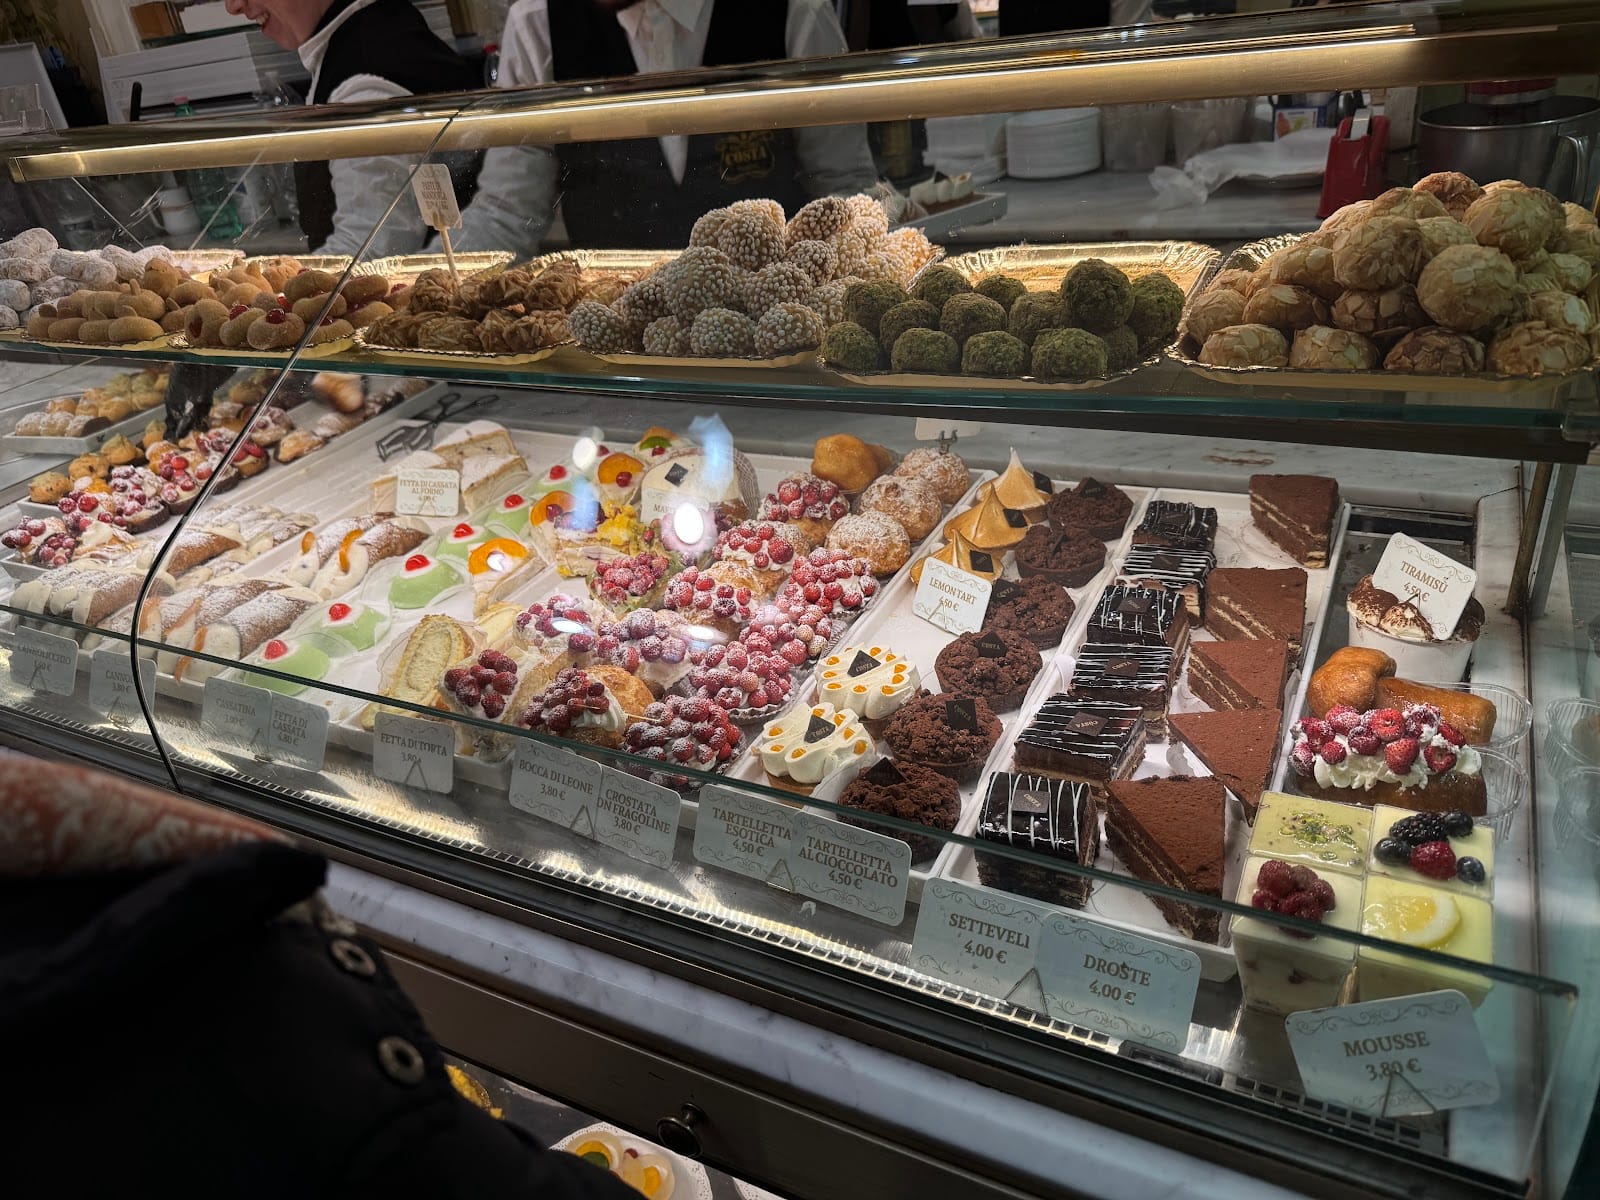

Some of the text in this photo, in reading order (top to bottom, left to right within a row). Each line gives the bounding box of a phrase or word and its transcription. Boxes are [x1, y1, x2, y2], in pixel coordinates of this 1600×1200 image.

[399, 479, 419, 488] FETTA
[420, 480, 428, 488] DI
[929, 577, 977, 605] LEMON TART
[1421, 592, 1431, 602] €
[953, 602, 960, 612] €
[272, 719, 306, 739] CASSATA
[274, 710, 308, 729] FETTA DI
[380, 732, 448, 757] FETTA DI TORTA
[519, 759, 594, 795] BOCCA DI LEONE
[540, 783, 567, 801] 3,80 €
[605, 788, 658, 818] CROSTATA
[597, 796, 671, 834] ON FRAGOLINE
[614, 816, 641, 836] 3,80 €
[712, 806, 792, 841] TARTELLETTA
[725, 824, 775, 848] ESOTICA
[756, 846, 765, 857] €
[806, 835, 893, 874] TARTELLETTA
[798, 846, 898, 888] AL CIOCCOLATO
[853, 878, 863, 890] €
[949, 912, 1031, 949] SETTEVELI
[963, 939, 1008, 964] 4,00 €
[1083, 954, 1152, 987] DROSTE
[1089, 979, 1137, 1006] 4,00 €
[1343, 1030, 1430, 1057] MOUSSE
[1365, 1057, 1422, 1082] 3,80 €
